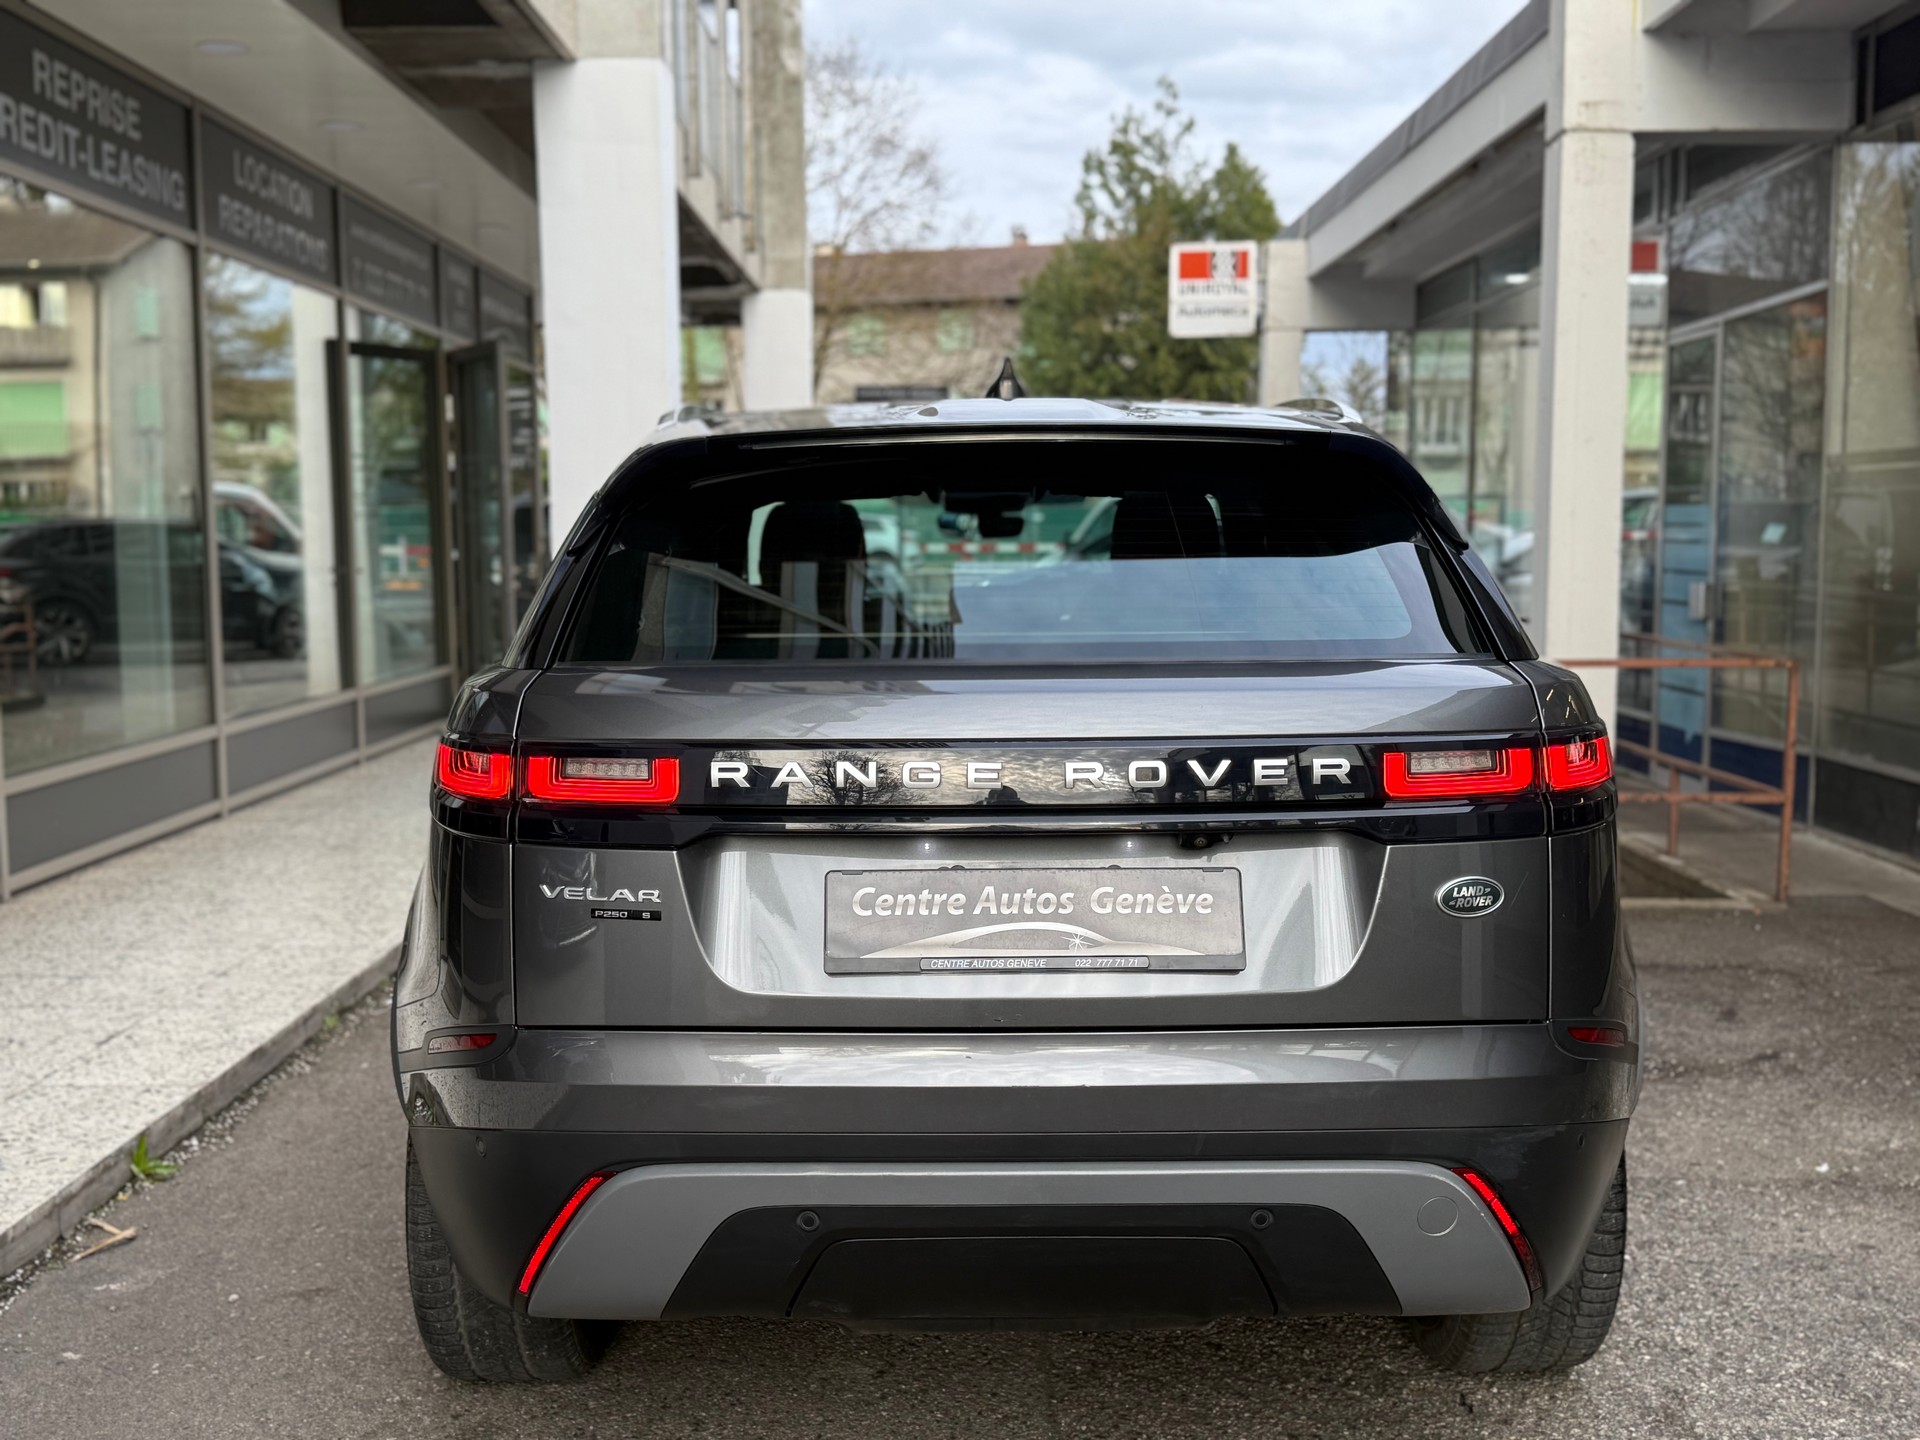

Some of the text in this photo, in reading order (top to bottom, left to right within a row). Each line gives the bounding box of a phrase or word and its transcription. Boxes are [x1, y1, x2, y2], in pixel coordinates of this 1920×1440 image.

[32, 48, 142, 142] REPRISE
[233, 149, 314, 221] LOCATION
[710, 758, 1352, 789] RANGE ROVER
[539, 884, 662, 903] VELAR
[1453, 886, 1484, 897] LAND
[852, 885, 1215, 917] Centre Autos Genève
[1455, 896, 1493, 907] ROVER
[594, 910, 628, 919] P250
[930, 958, 1047, 968] CENTRE AUTOS GENEVE
[1075, 958, 1139, 967] 022 777 71 71
